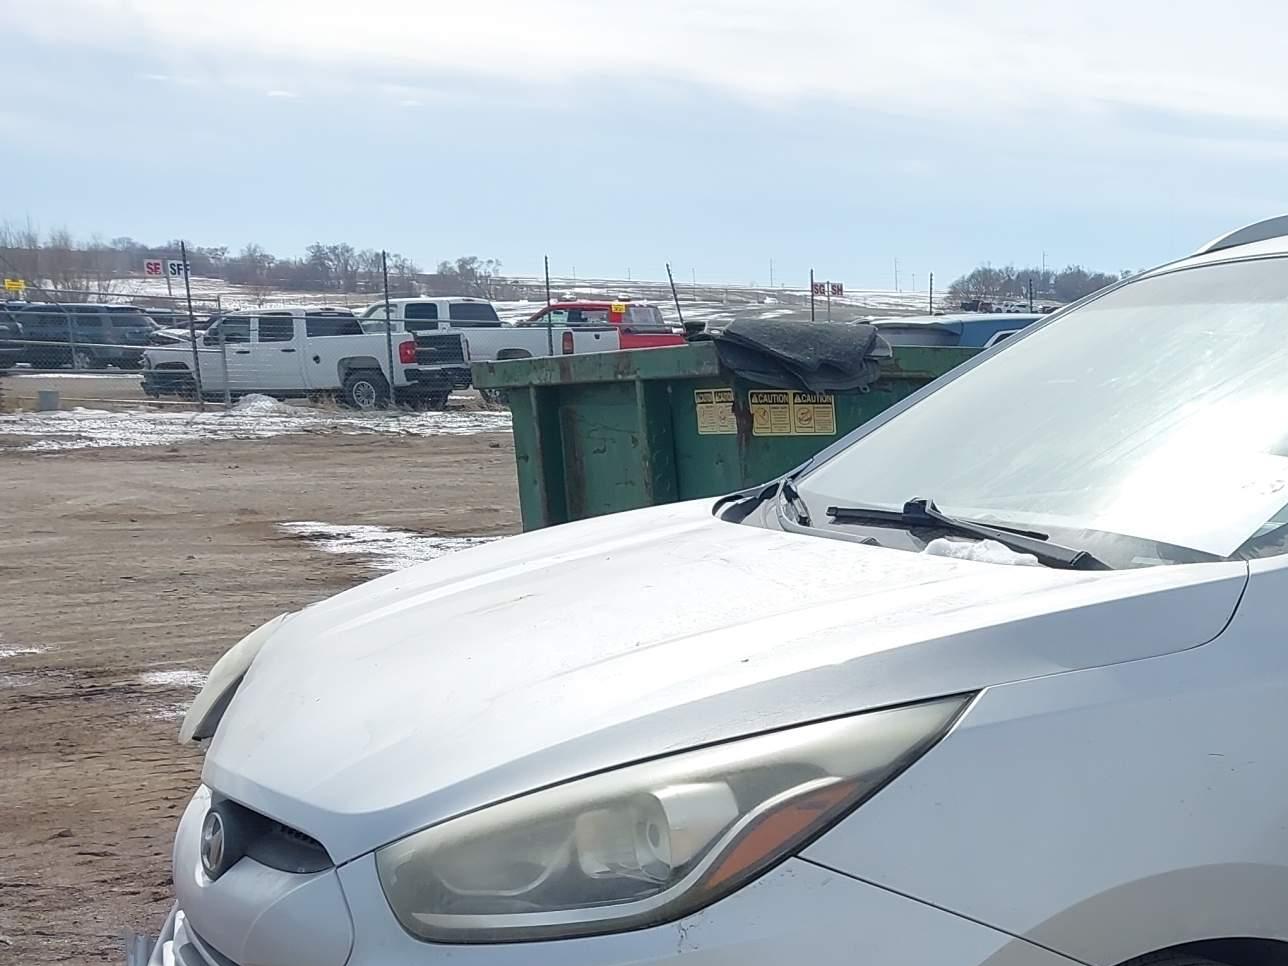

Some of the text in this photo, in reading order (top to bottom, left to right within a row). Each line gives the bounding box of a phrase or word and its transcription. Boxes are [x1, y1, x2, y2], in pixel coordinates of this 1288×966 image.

[831, 285, 843, 296] SH
[759, 394, 789, 404] CAUTION
[801, 393, 833, 404] CAUTION
